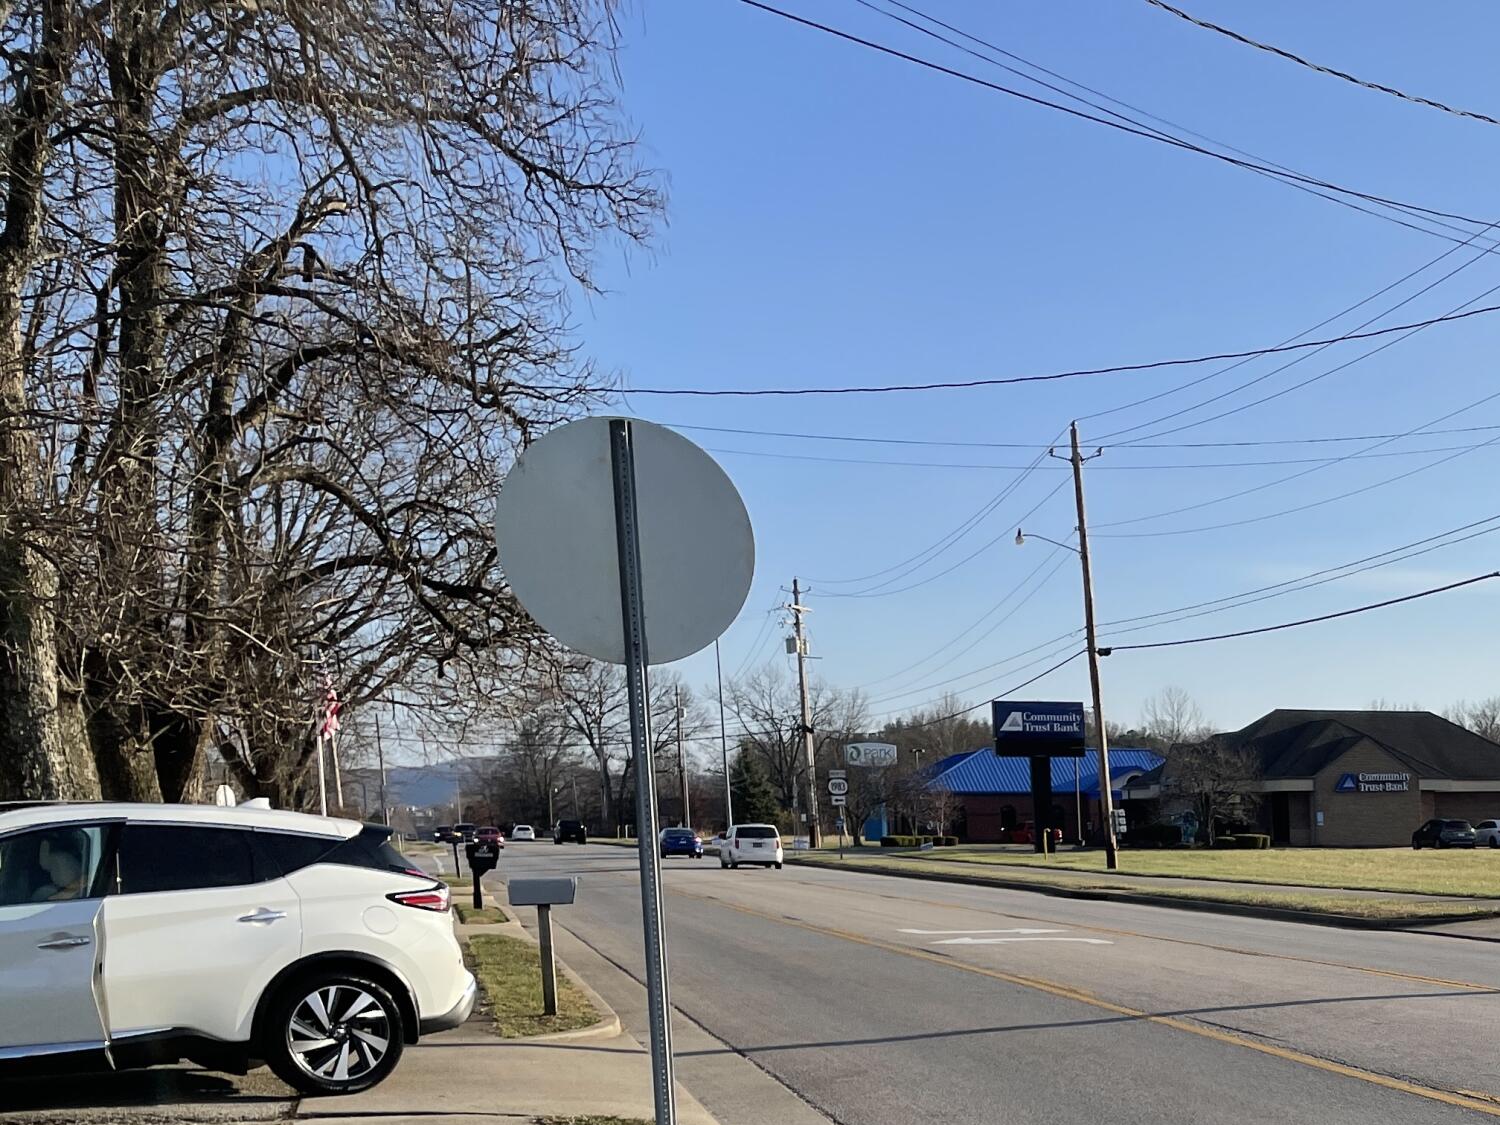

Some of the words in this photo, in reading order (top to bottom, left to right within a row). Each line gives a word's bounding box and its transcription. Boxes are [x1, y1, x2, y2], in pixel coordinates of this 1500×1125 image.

[1023, 711, 1082, 723] Community
[1024, 722, 1051, 732] Trust
[1053, 722, 1080, 732] Bank
[863, 746, 893, 759] Park
[1359, 772, 1410, 781] Community
[1360, 782, 1383, 791] Trust
[1385, 782, 1408, 791] Bank
